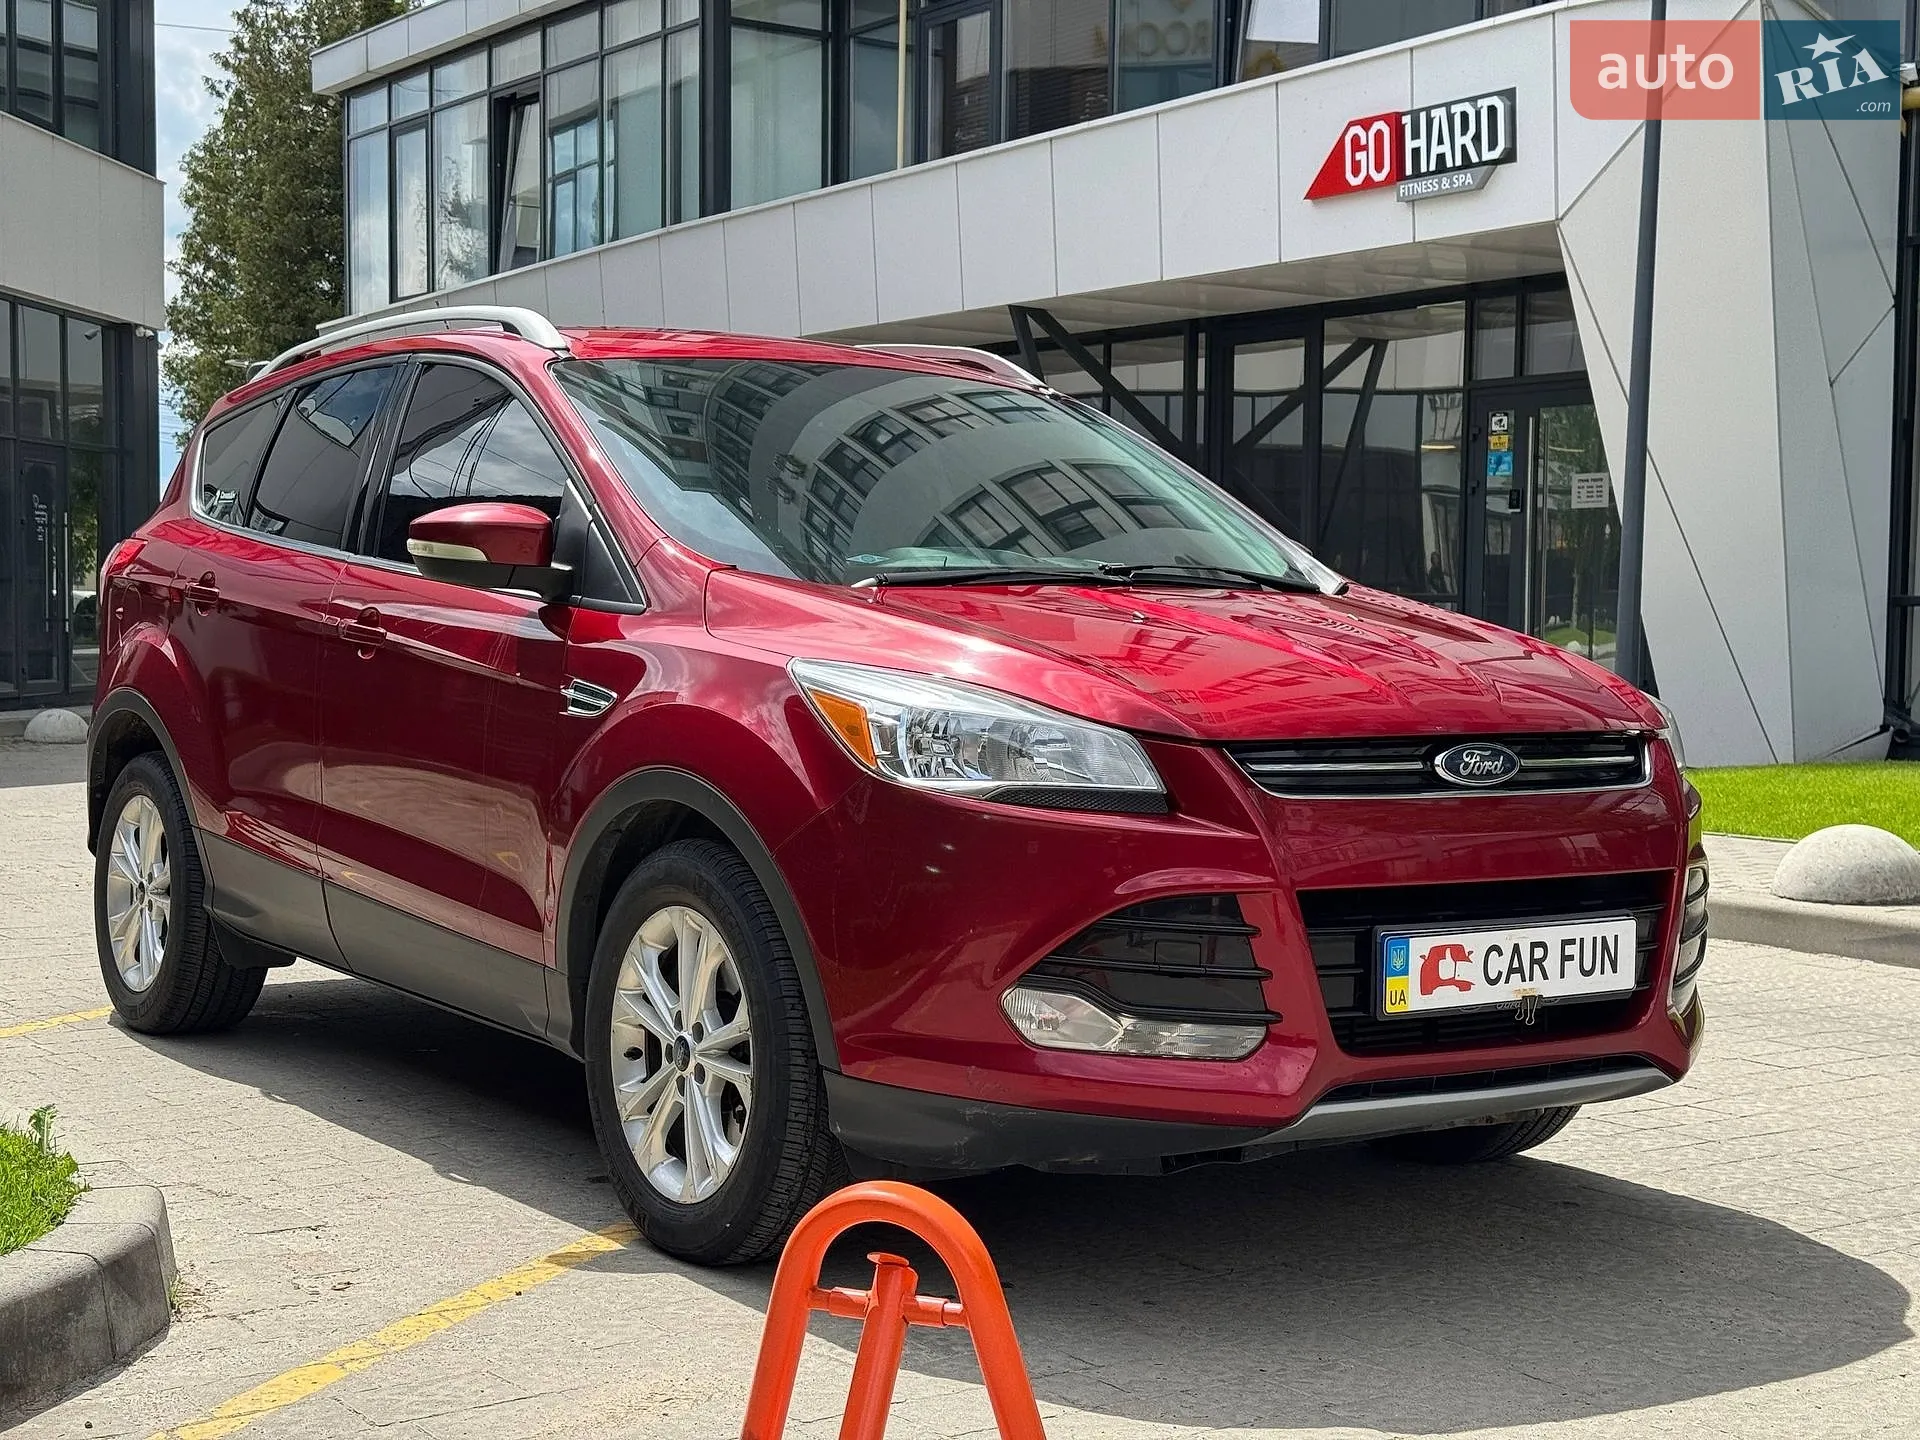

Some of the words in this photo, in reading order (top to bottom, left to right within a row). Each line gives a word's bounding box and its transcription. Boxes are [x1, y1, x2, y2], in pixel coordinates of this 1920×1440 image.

[1344, 120, 1391, 186] GO
[1402, 95, 1506, 176] HARD
[1400, 178, 1440, 197] FITNESS
[1441, 177, 1451, 190] &
[1452, 173, 1474, 189] SPA
[1459, 749, 1505, 776] Ford
[1483, 940, 1549, 986] CAR
[1559, 934, 1619, 980] FUN
[1390, 990, 1406, 1006] UA
